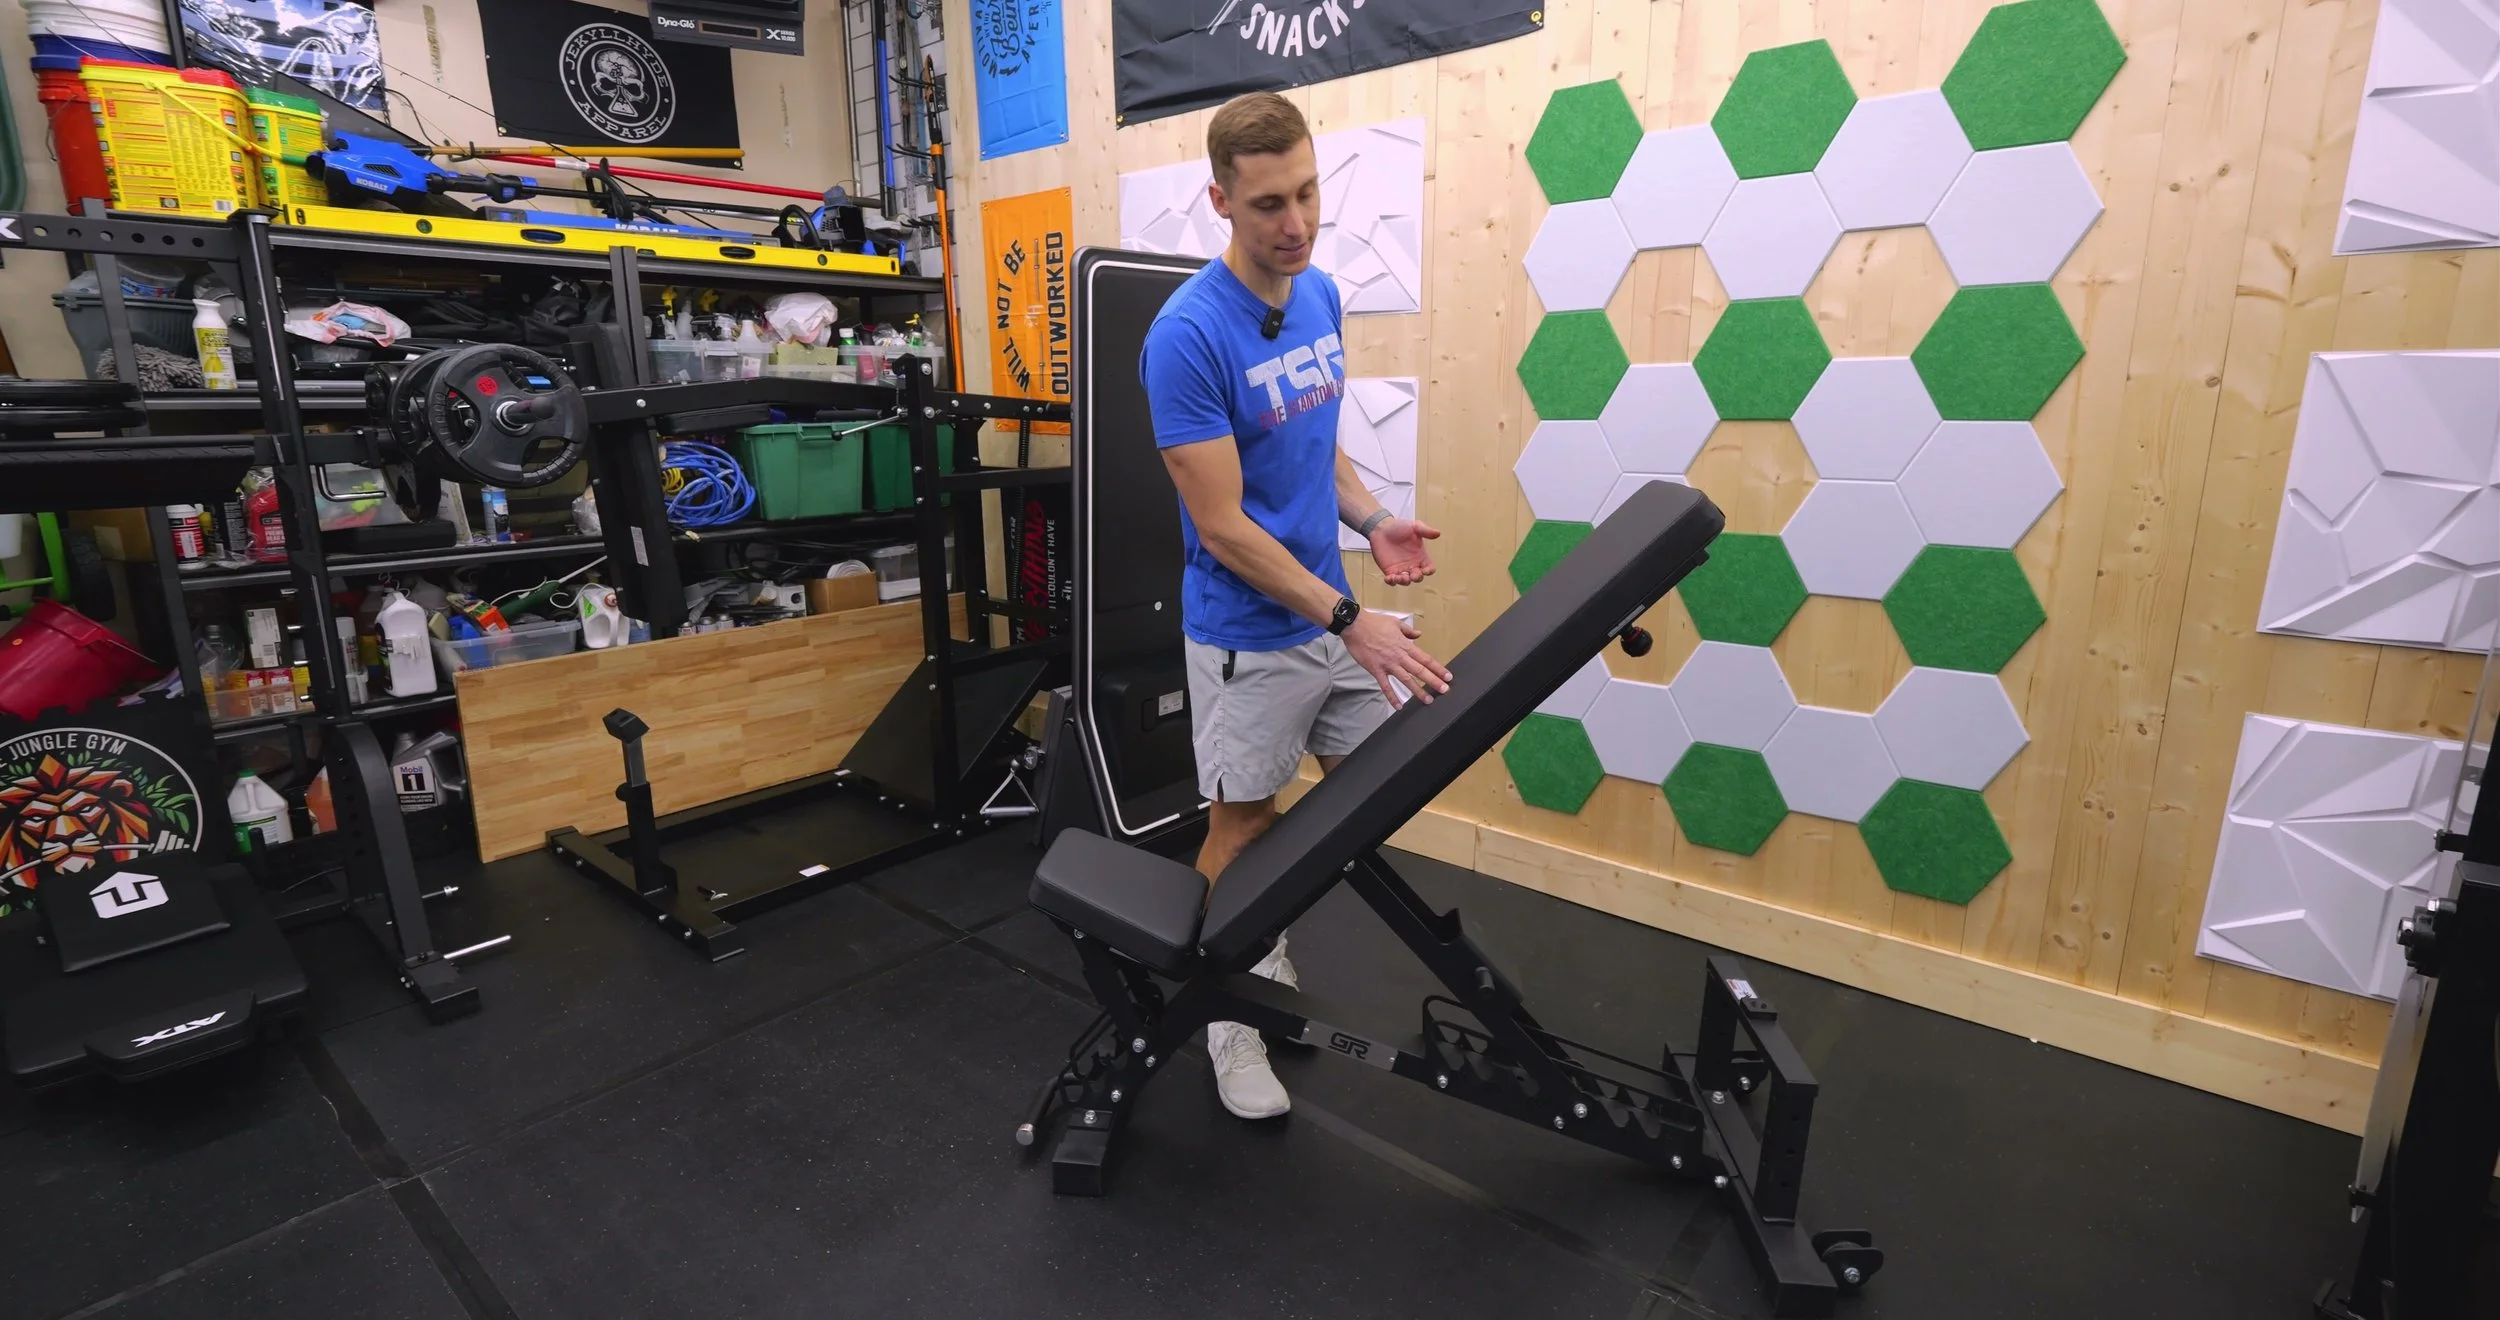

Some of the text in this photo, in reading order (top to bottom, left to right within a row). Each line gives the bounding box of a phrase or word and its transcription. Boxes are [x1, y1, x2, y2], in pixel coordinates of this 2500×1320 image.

[565, 28, 669, 88] JEKYLLHYDE
[577, 101, 667, 139] APPAREL
[997, 239, 1031, 393] WILL NOT BE
[1045, 230, 1071, 396] OUTWORKED
[1046, 519, 1056, 547] HAVE
[8, 733, 128, 761] JUNGLE GYM
[400, 765, 424, 774] Mobil
[407, 774, 419, 791] 1
[130, 1011, 227, 1048] ATX
